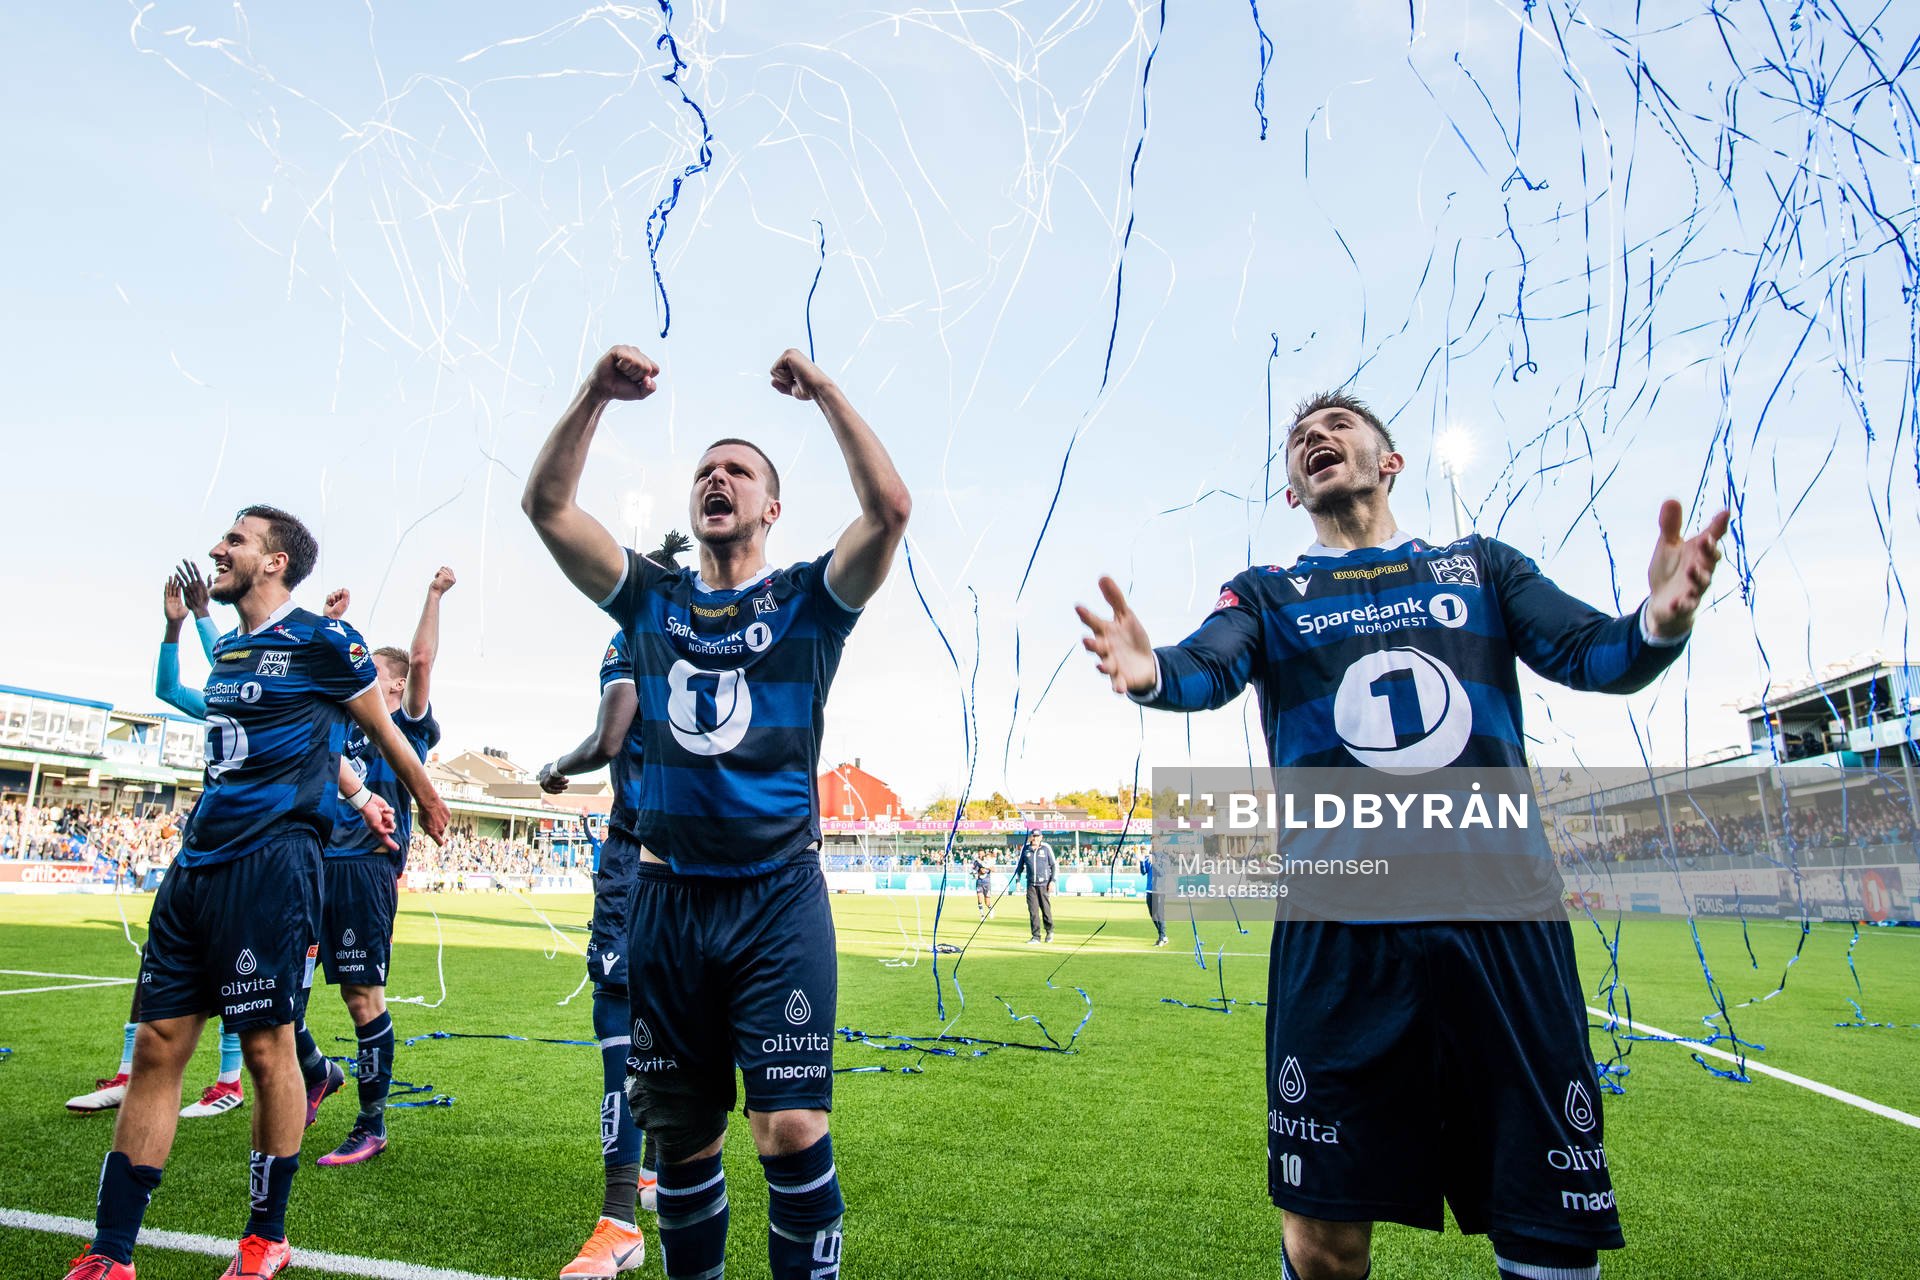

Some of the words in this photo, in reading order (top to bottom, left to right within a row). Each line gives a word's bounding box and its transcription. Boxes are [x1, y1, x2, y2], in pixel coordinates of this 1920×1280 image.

[1296, 597, 1425, 634] SpareBank
[1354, 616, 1428, 634] NORDVEST
[688, 642, 744, 655] NORDVEST
[1696, 897, 1725, 914] FOKUS
[221, 977, 277, 997] olivita
[225, 998, 273, 1015] macron
[762, 1032, 830, 1053] olivita
[766, 1065, 827, 1080] macron
[1268, 1109, 1339, 1145] olivita
[1280, 1152, 1302, 1187] 10
